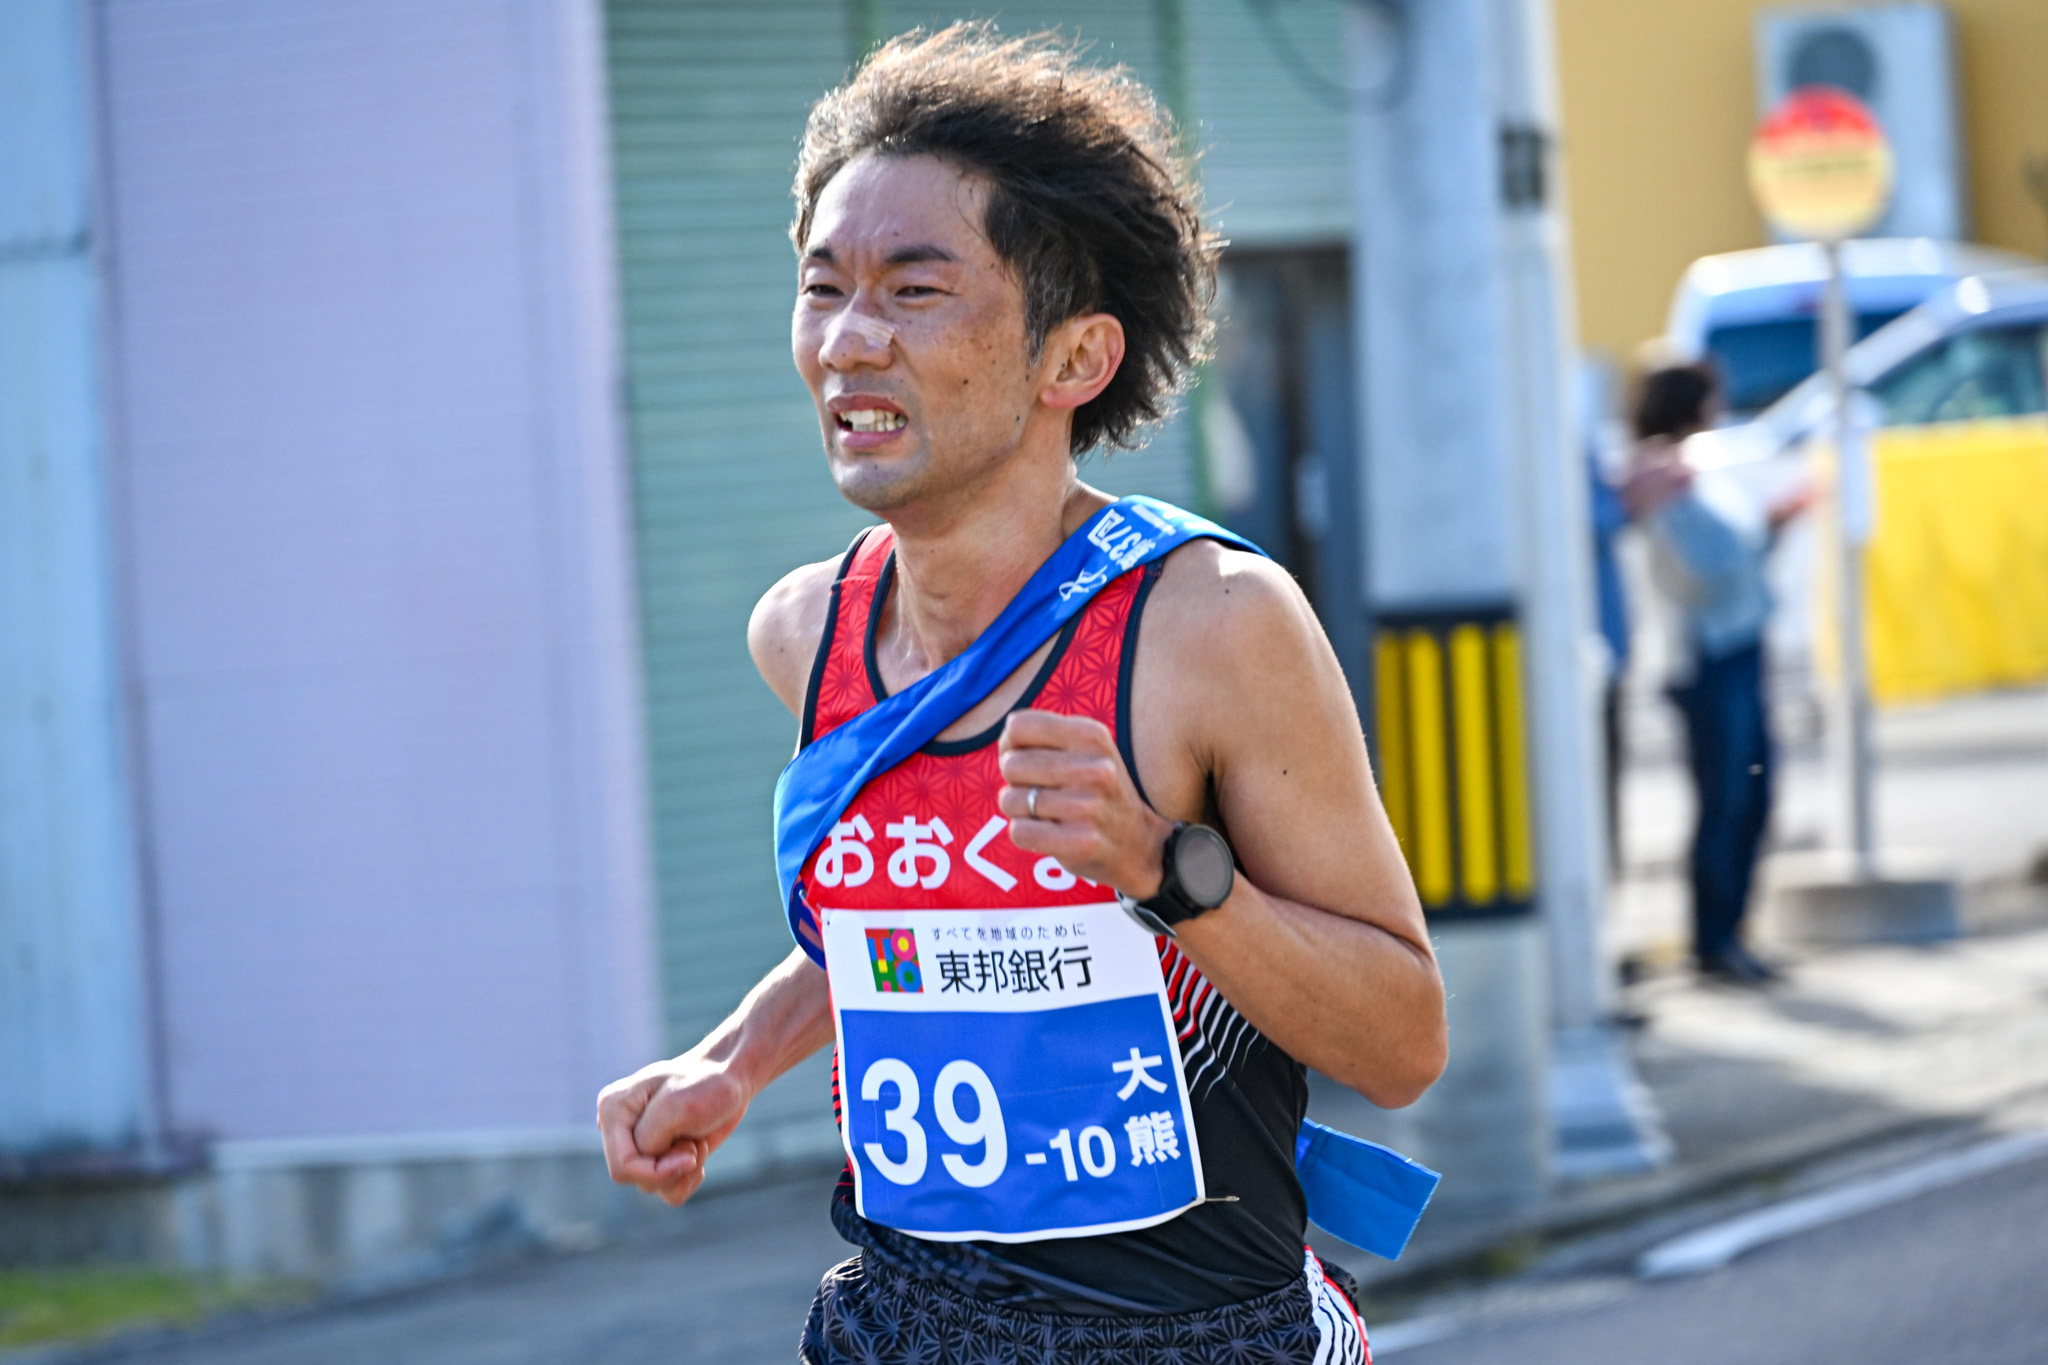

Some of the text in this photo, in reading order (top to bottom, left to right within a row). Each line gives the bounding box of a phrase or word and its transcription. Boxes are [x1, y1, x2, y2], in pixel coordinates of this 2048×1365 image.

[931, 923, 1086, 941] すべてを地域のために
[935, 945, 1092, 993] 東邦銀行
[1112, 1047, 1181, 1167] 大熊
